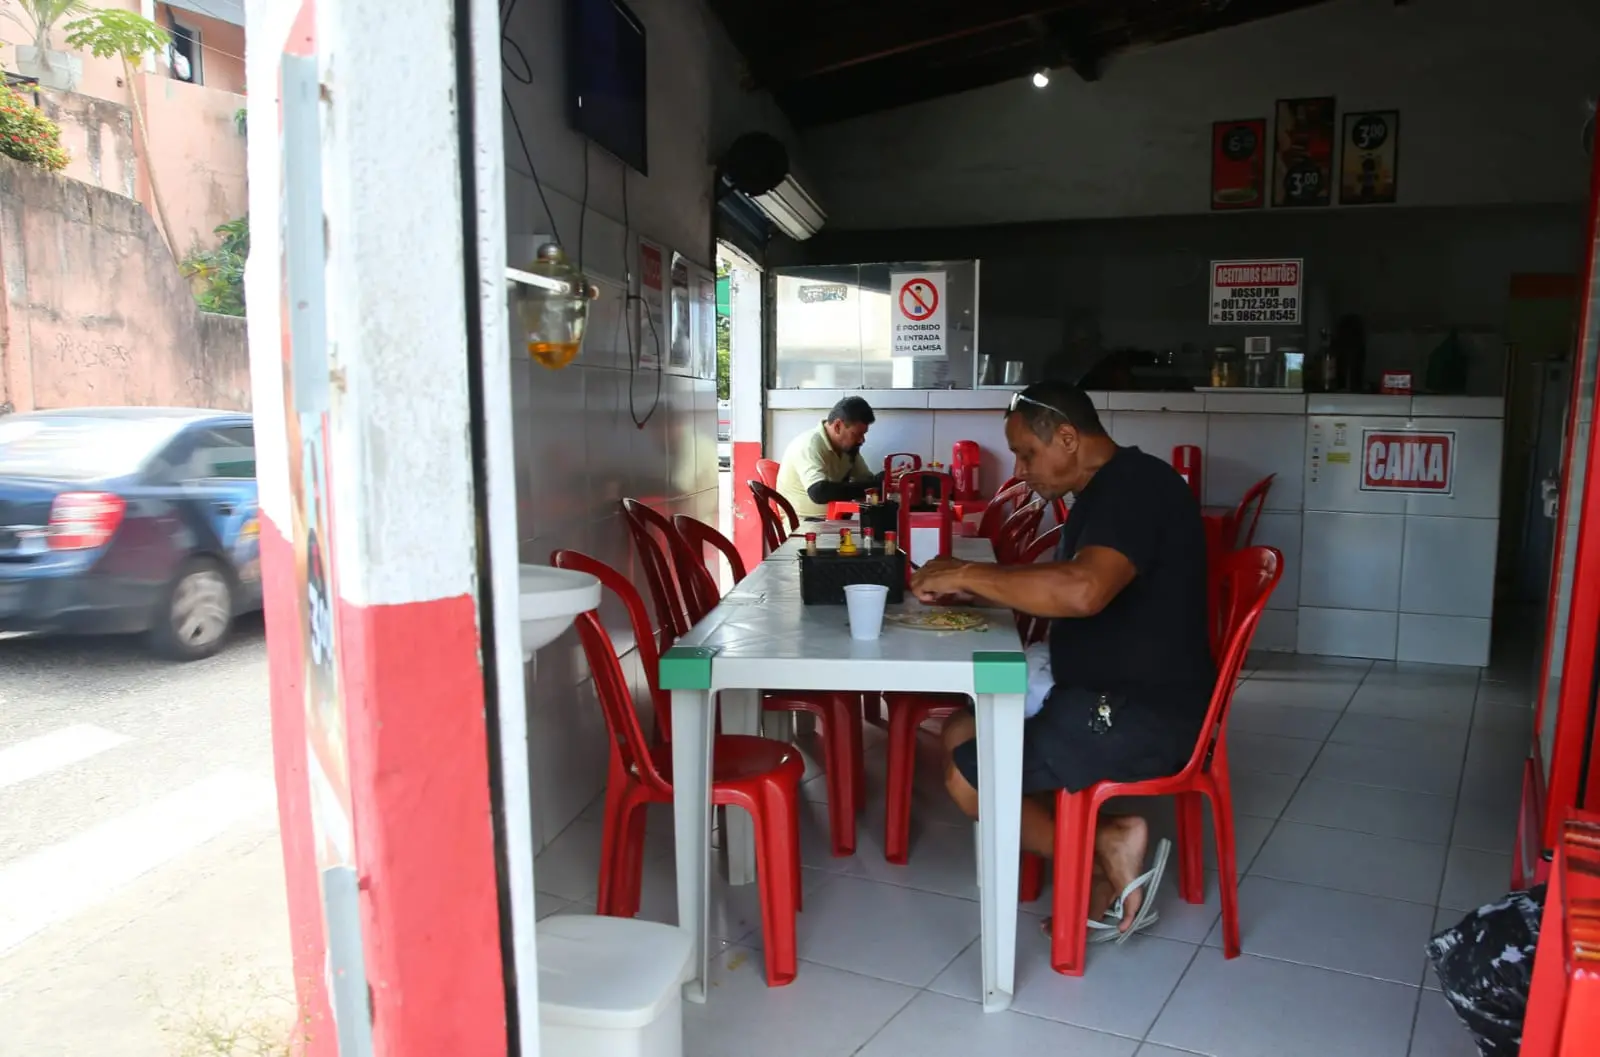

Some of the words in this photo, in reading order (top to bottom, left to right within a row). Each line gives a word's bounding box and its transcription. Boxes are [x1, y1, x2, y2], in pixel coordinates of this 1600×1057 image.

[1217, 267, 1260, 284] ACEITAMOS
[1261, 264, 1296, 282] CARTÕES
[1231, 288, 1262, 298] NOSSO
[1264, 288, 1280, 297] PIX
[1221, 310, 1234, 321] 85
[1236, 310, 1296, 320] 98621.8545
[1368, 441, 1444, 482] CAIXA
